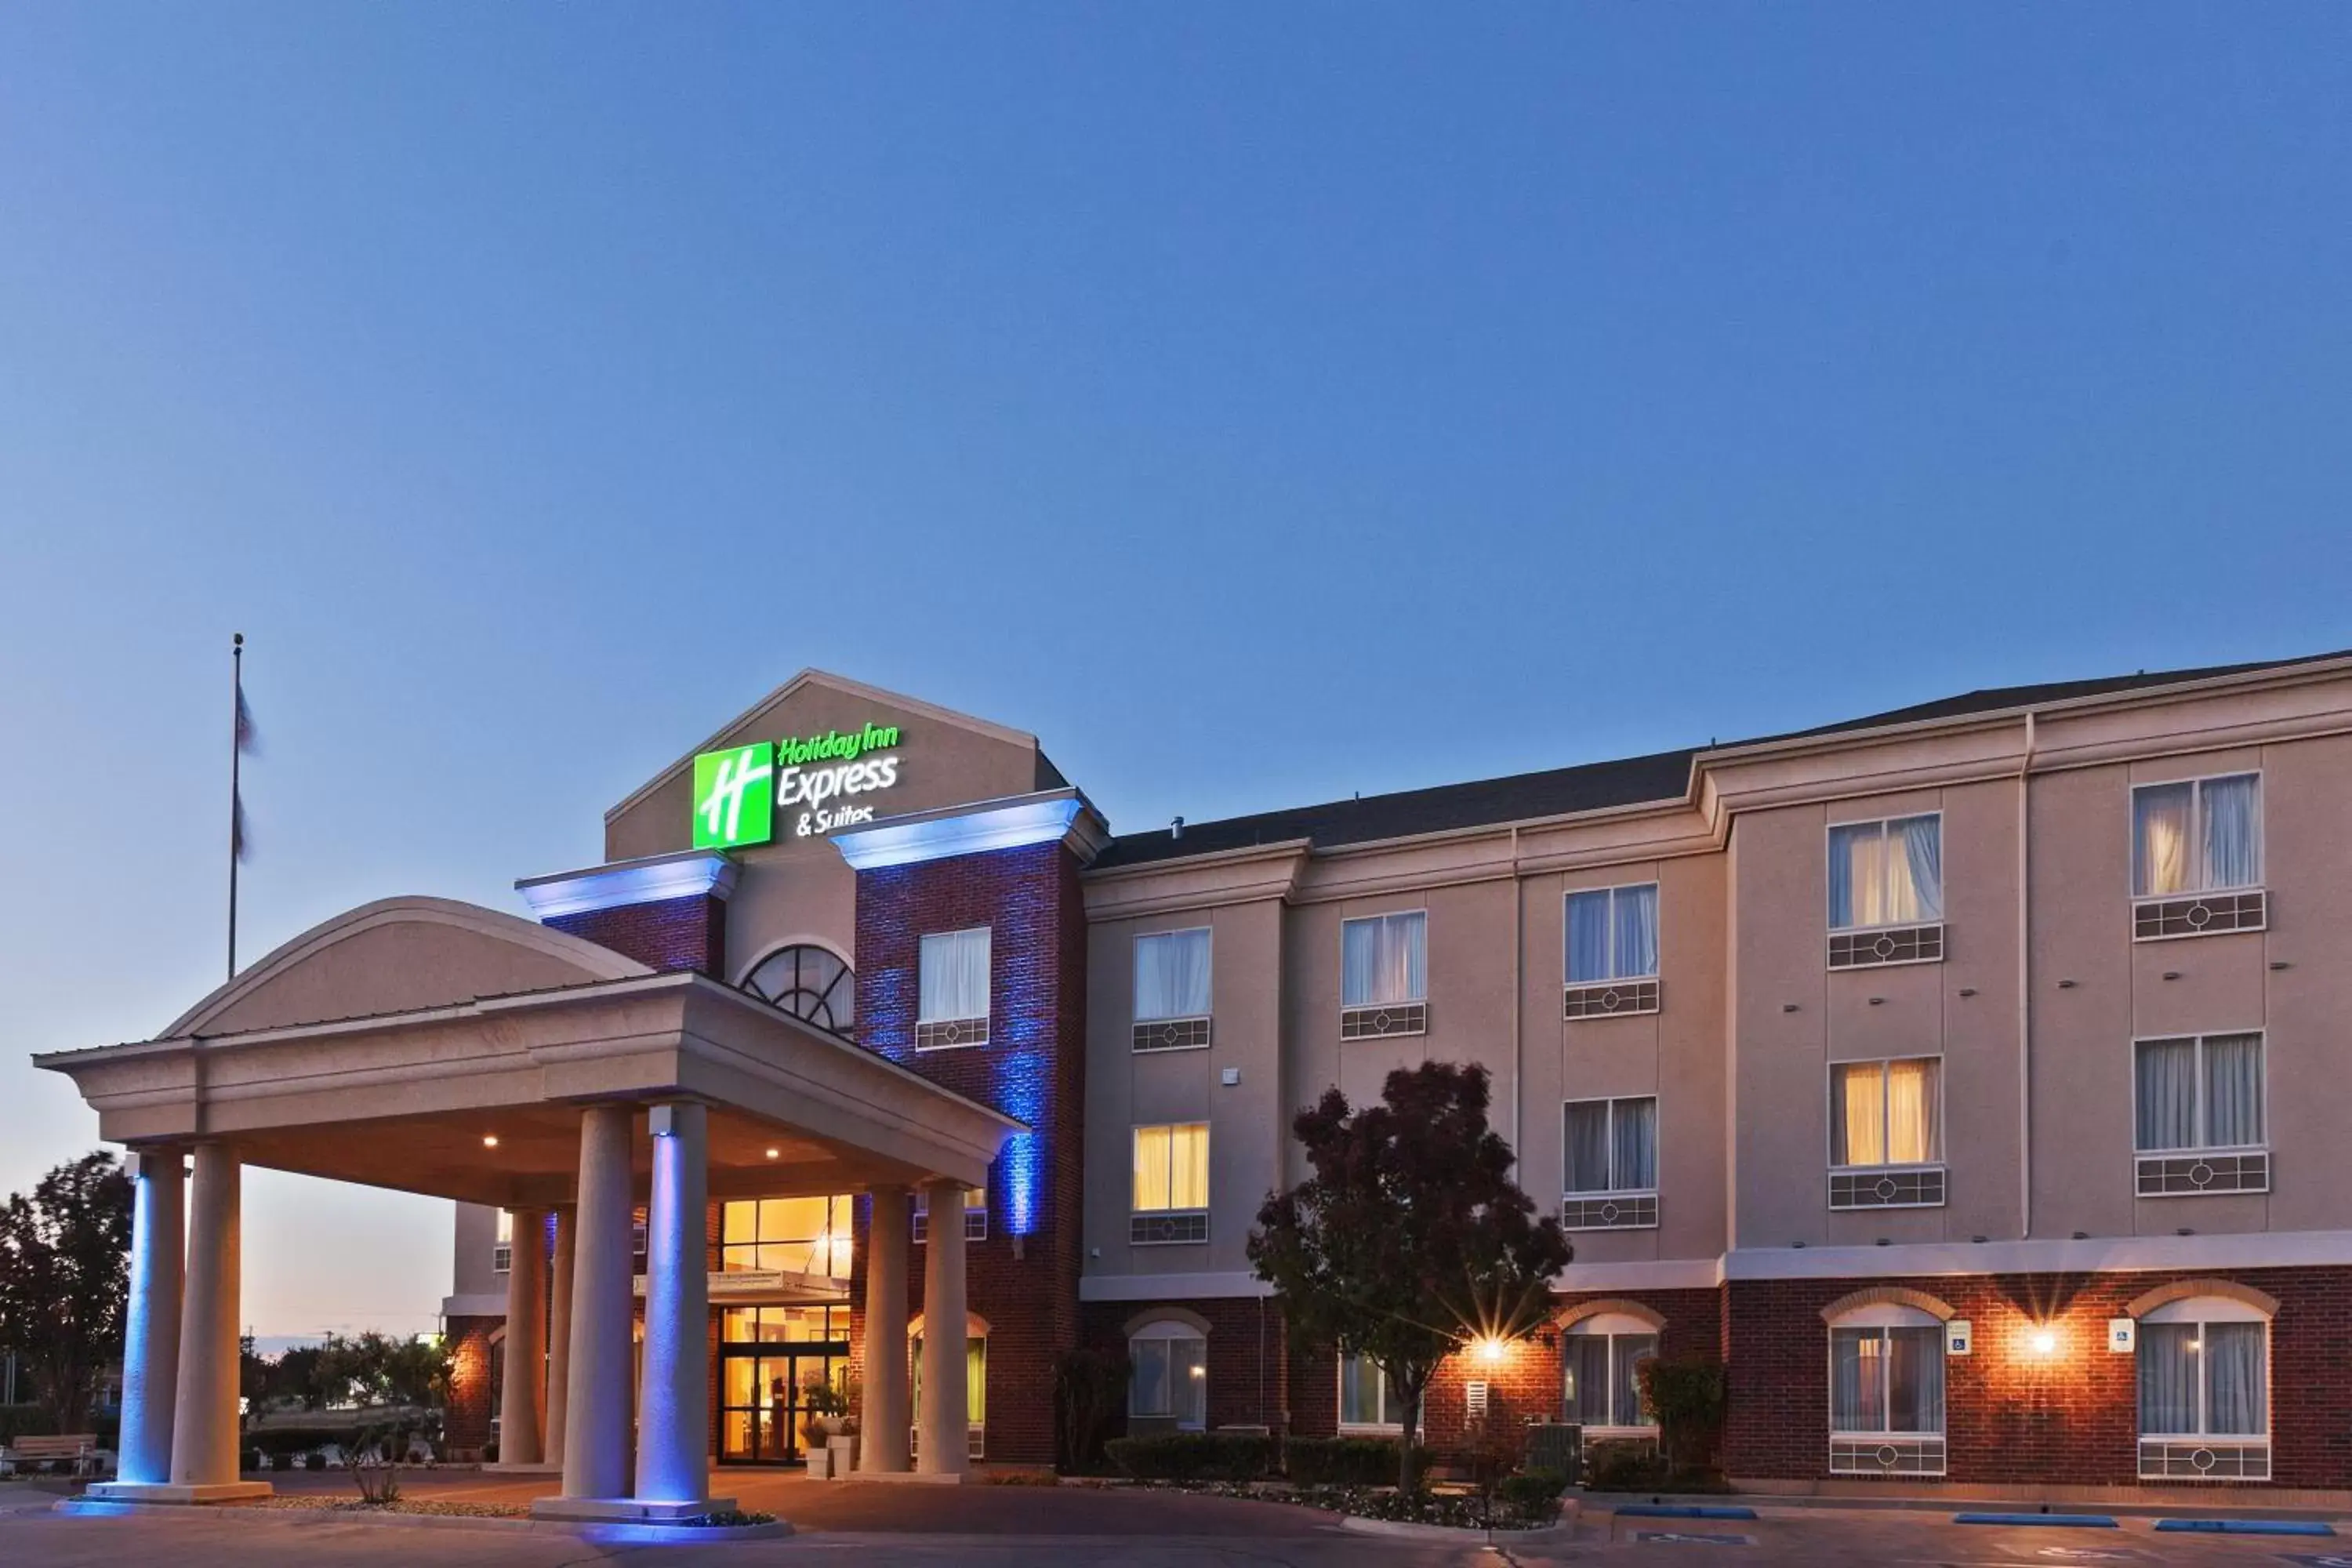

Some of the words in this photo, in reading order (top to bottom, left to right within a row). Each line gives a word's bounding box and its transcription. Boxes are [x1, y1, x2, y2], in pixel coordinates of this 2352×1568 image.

[777, 730, 862, 766] Holiday
[862, 722, 898, 751] Inn
[777, 757, 898, 811] Express
[796, 812, 812, 837] &
[813, 805, 874, 833] Suites
